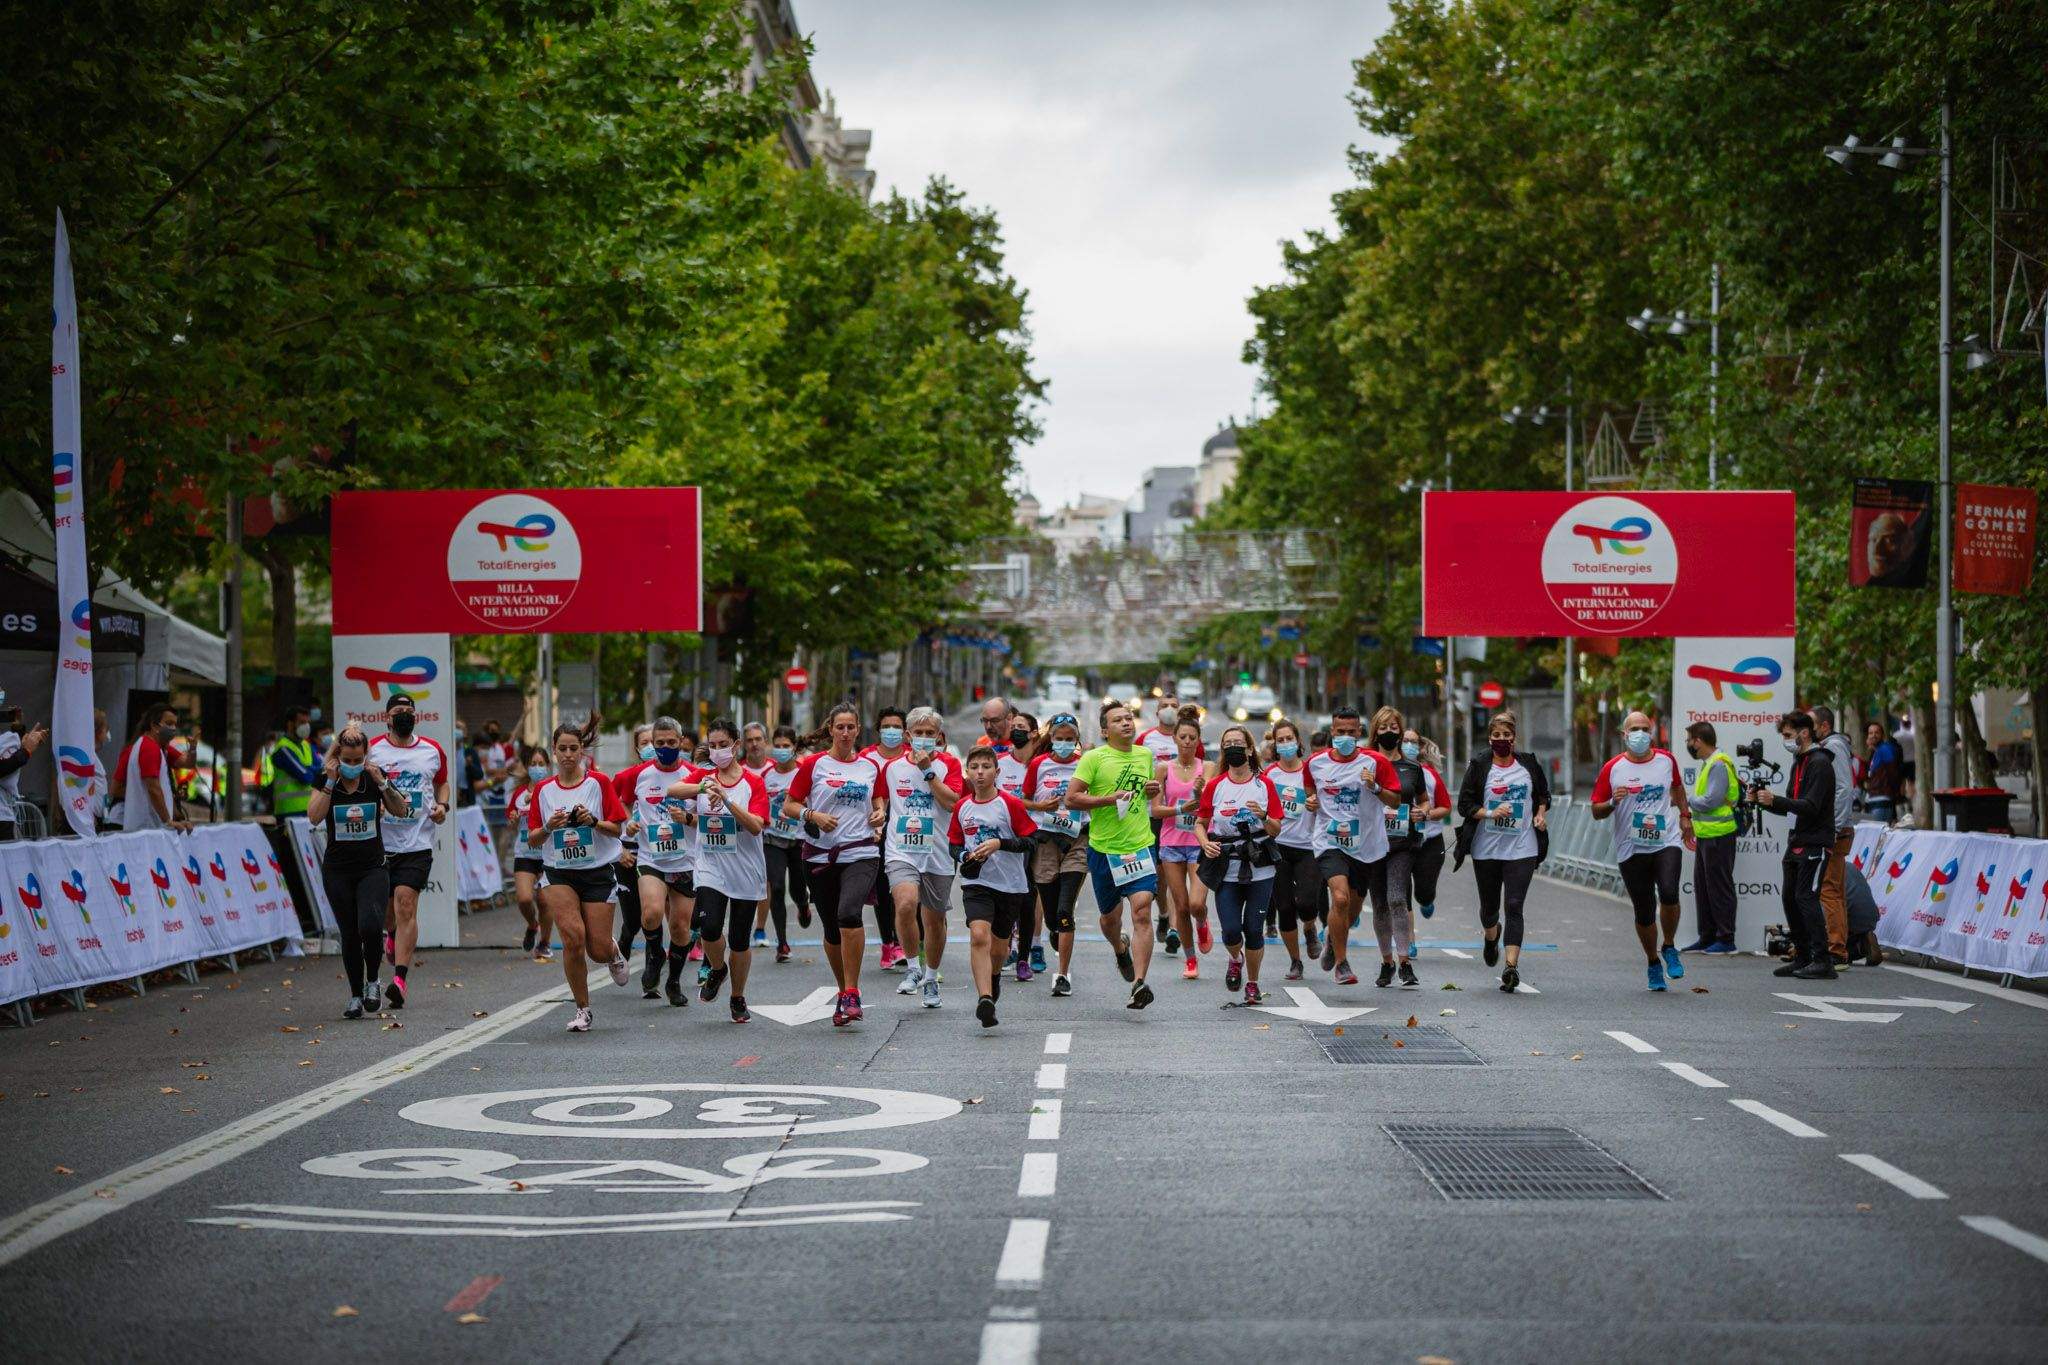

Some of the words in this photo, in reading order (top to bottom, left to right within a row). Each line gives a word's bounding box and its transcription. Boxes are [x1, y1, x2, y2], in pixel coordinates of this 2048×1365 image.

[1965, 504, 2026, 519] FERNÁN
[1964, 517, 2026, 533] GÓMEZ
[477, 560, 556, 572] TotalEnergies
[1572, 563, 1652, 575] TotalEnergies
[497, 584, 534, 593] MILLA
[1591, 587, 1630, 597] MILLA
[483, 607, 499, 617] DE
[502, 607, 548, 617] MADRID
[1577, 610, 1594, 620] DE
[1597, 610, 1643, 620] MADRID
[1687, 711, 1782, 726] TotalEnergies
[345, 822, 368, 833] 1136
[1052, 816, 1073, 829] 1207
[706, 834, 727, 846] 1118
[903, 833, 924, 845] 1131
[1638, 829, 1660, 840] 1059
[656, 840, 678, 852] 1148
[1335, 836, 1354, 848] 1141
[561, 846, 587, 860] 1003
[1122, 861, 1143, 875] 1111
